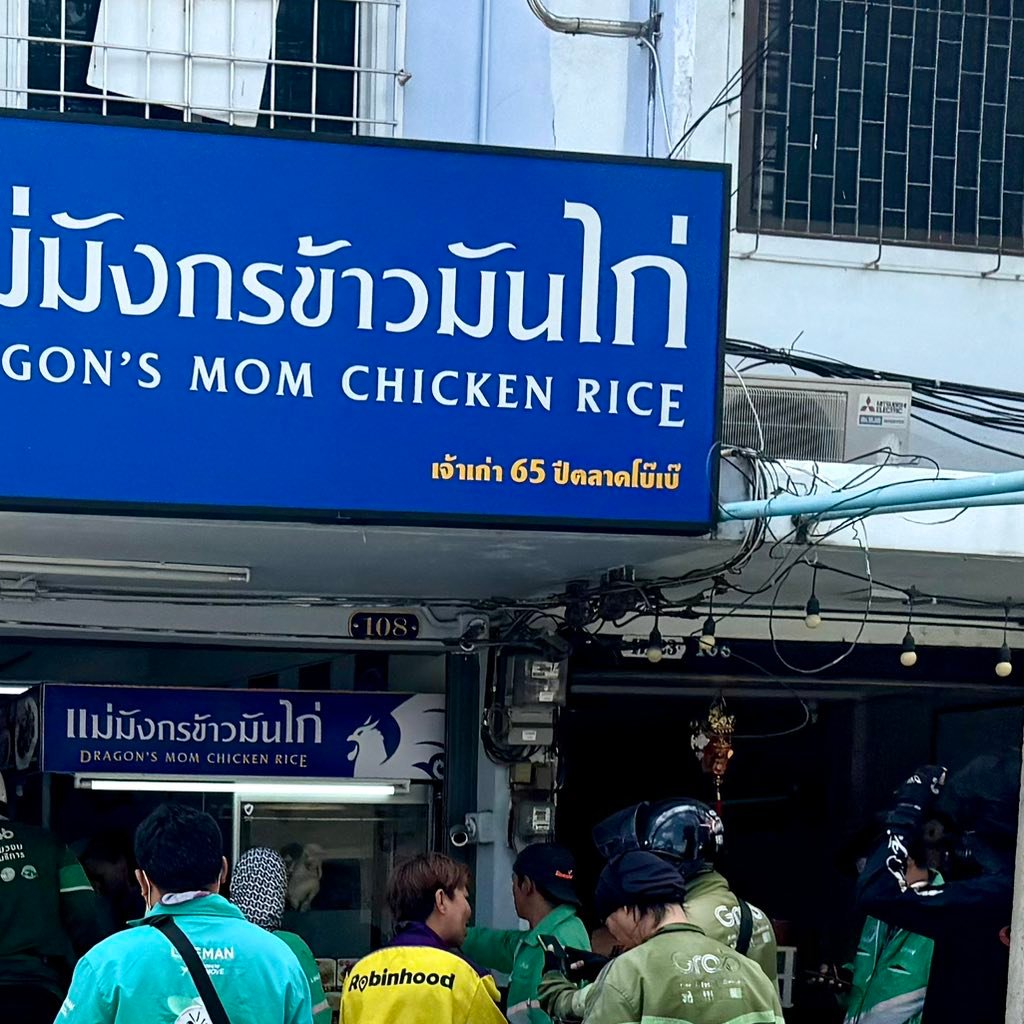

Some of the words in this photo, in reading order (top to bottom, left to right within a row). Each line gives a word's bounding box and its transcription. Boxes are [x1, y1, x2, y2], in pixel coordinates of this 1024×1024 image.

[189, 355, 314, 399] MOM
[341, 365, 554, 412] CHICKEN
[576, 378, 686, 428] RICE
[431, 453, 504, 482] เจ้าเก่า
[510, 459, 546, 484] 65
[363, 615, 407, 637] 108
[66, 699, 322, 744] แม่มังกรข้าวมันไก่
[80, 749, 158, 764] DRAGON'S
[165, 753, 200, 764] MOM
[207, 754, 269, 765] CHICKEN
[275, 755, 307, 768] RICE
[348, 967, 456, 993] Robinhood
